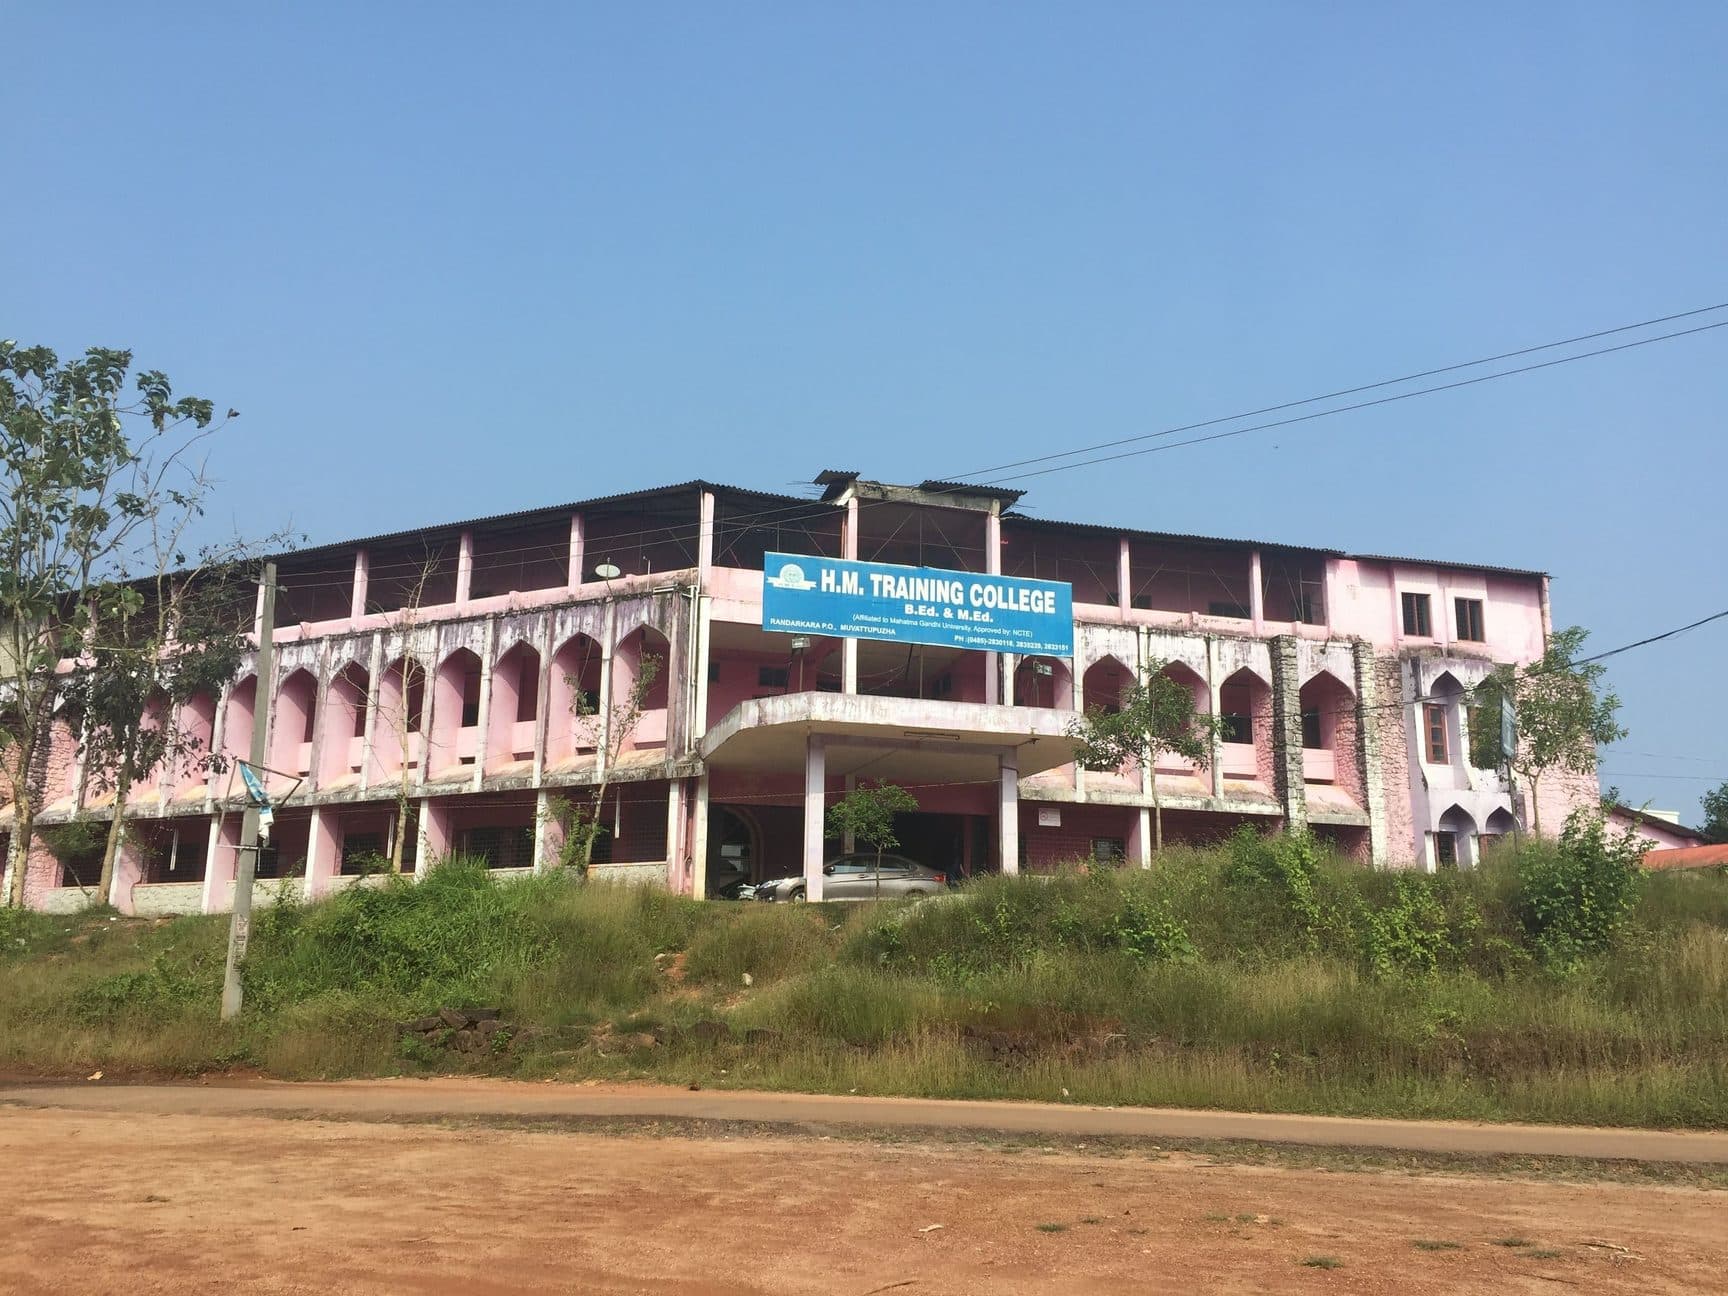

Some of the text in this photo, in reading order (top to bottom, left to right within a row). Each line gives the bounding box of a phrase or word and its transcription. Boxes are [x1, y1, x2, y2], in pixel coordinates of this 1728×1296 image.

[821, 569, 1056, 614] H.M. TRAINING COLLEGE
[904, 603, 994, 623] B.Ed. & M.Ed.
[770, 617, 821, 630] RANDARKARA
[840, 623, 896, 636] MUVATTUPUZHA
[889, 617, 918, 626] Mahatma
[919, 620, 941, 628] Gandhi
[973, 625, 1002, 635] Approved
